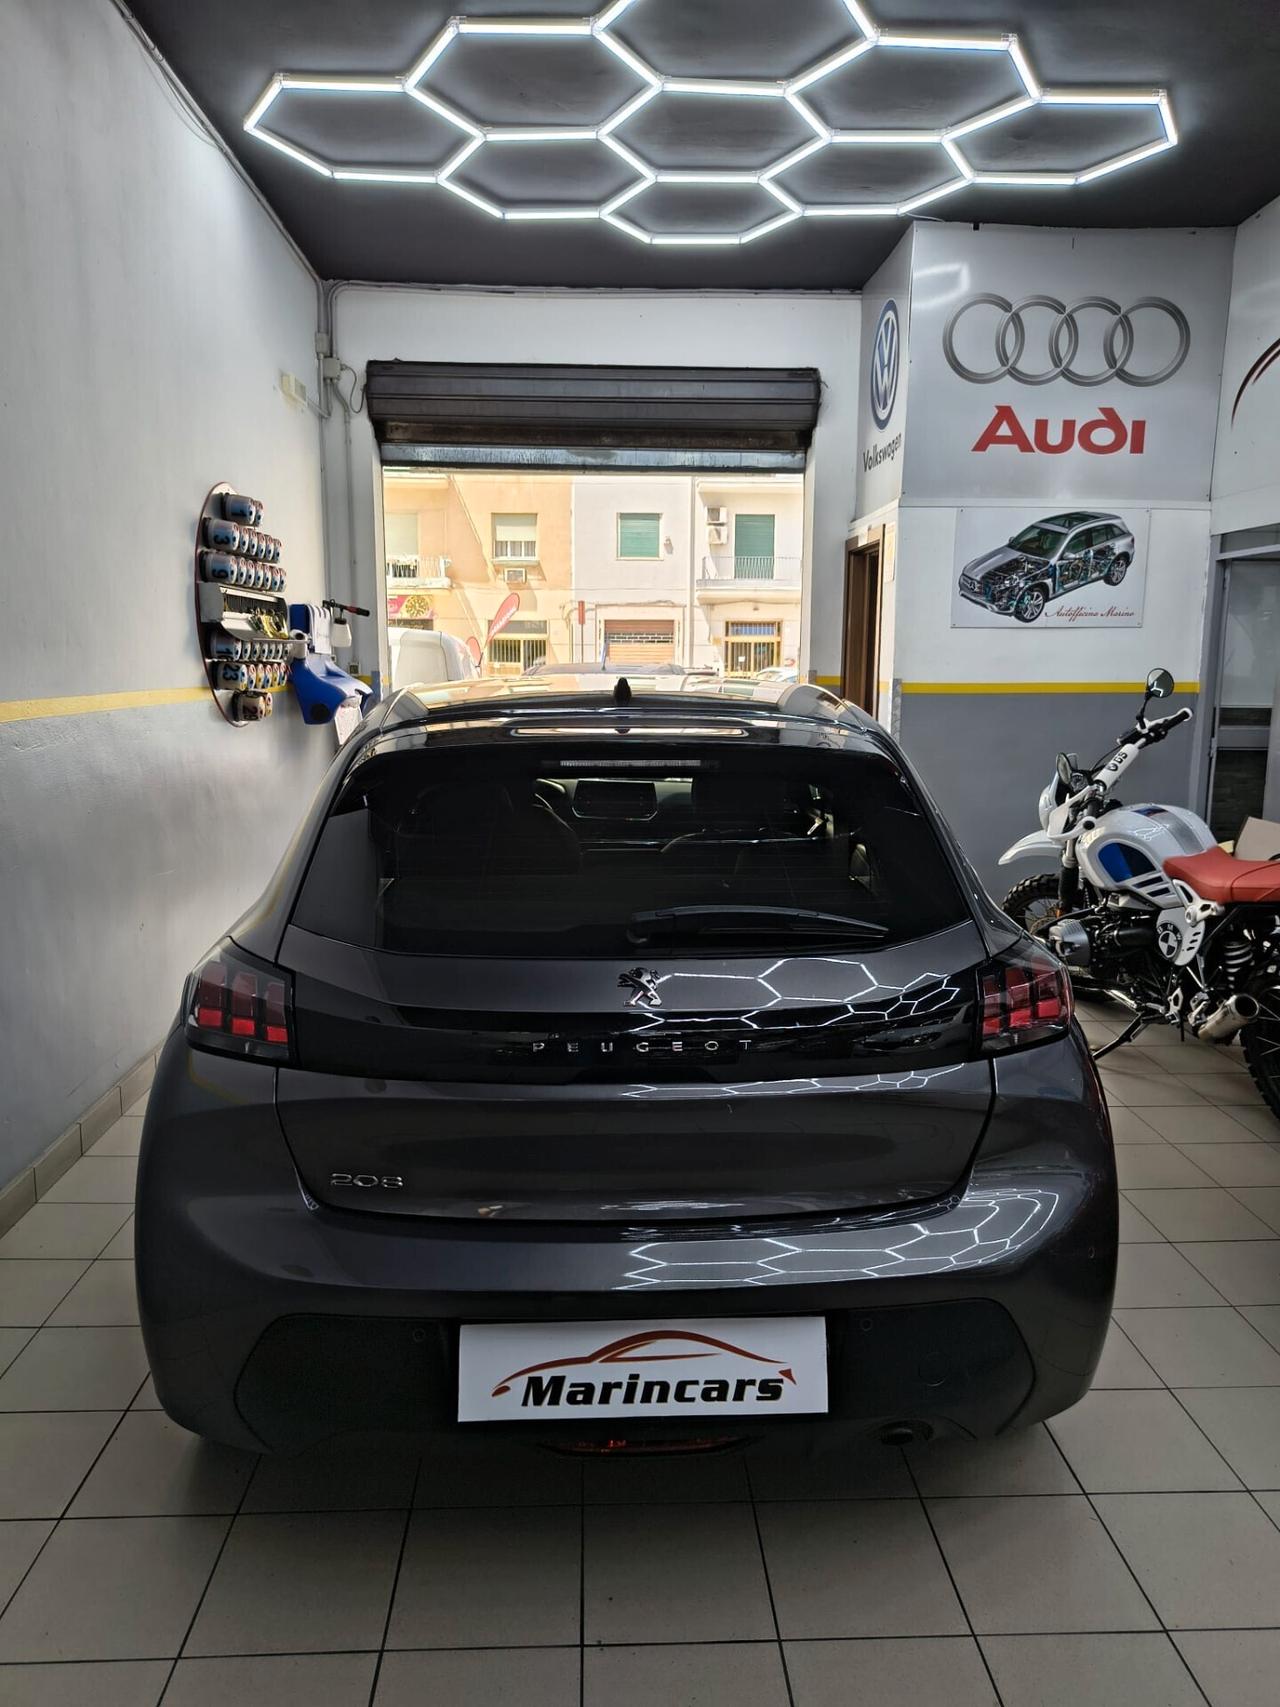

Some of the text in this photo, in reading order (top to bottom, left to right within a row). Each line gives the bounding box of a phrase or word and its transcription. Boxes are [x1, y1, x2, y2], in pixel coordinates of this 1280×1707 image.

[971, 405, 1146, 454] Audi
[862, 432, 902, 473] Volkswagen
[1044, 605, 1135, 622] Autofficina Marino
[532, 1039, 753, 1053] PEUGEOT
[330, 1173, 403, 1189] 208
[521, 1373, 784, 1407] Marincars
